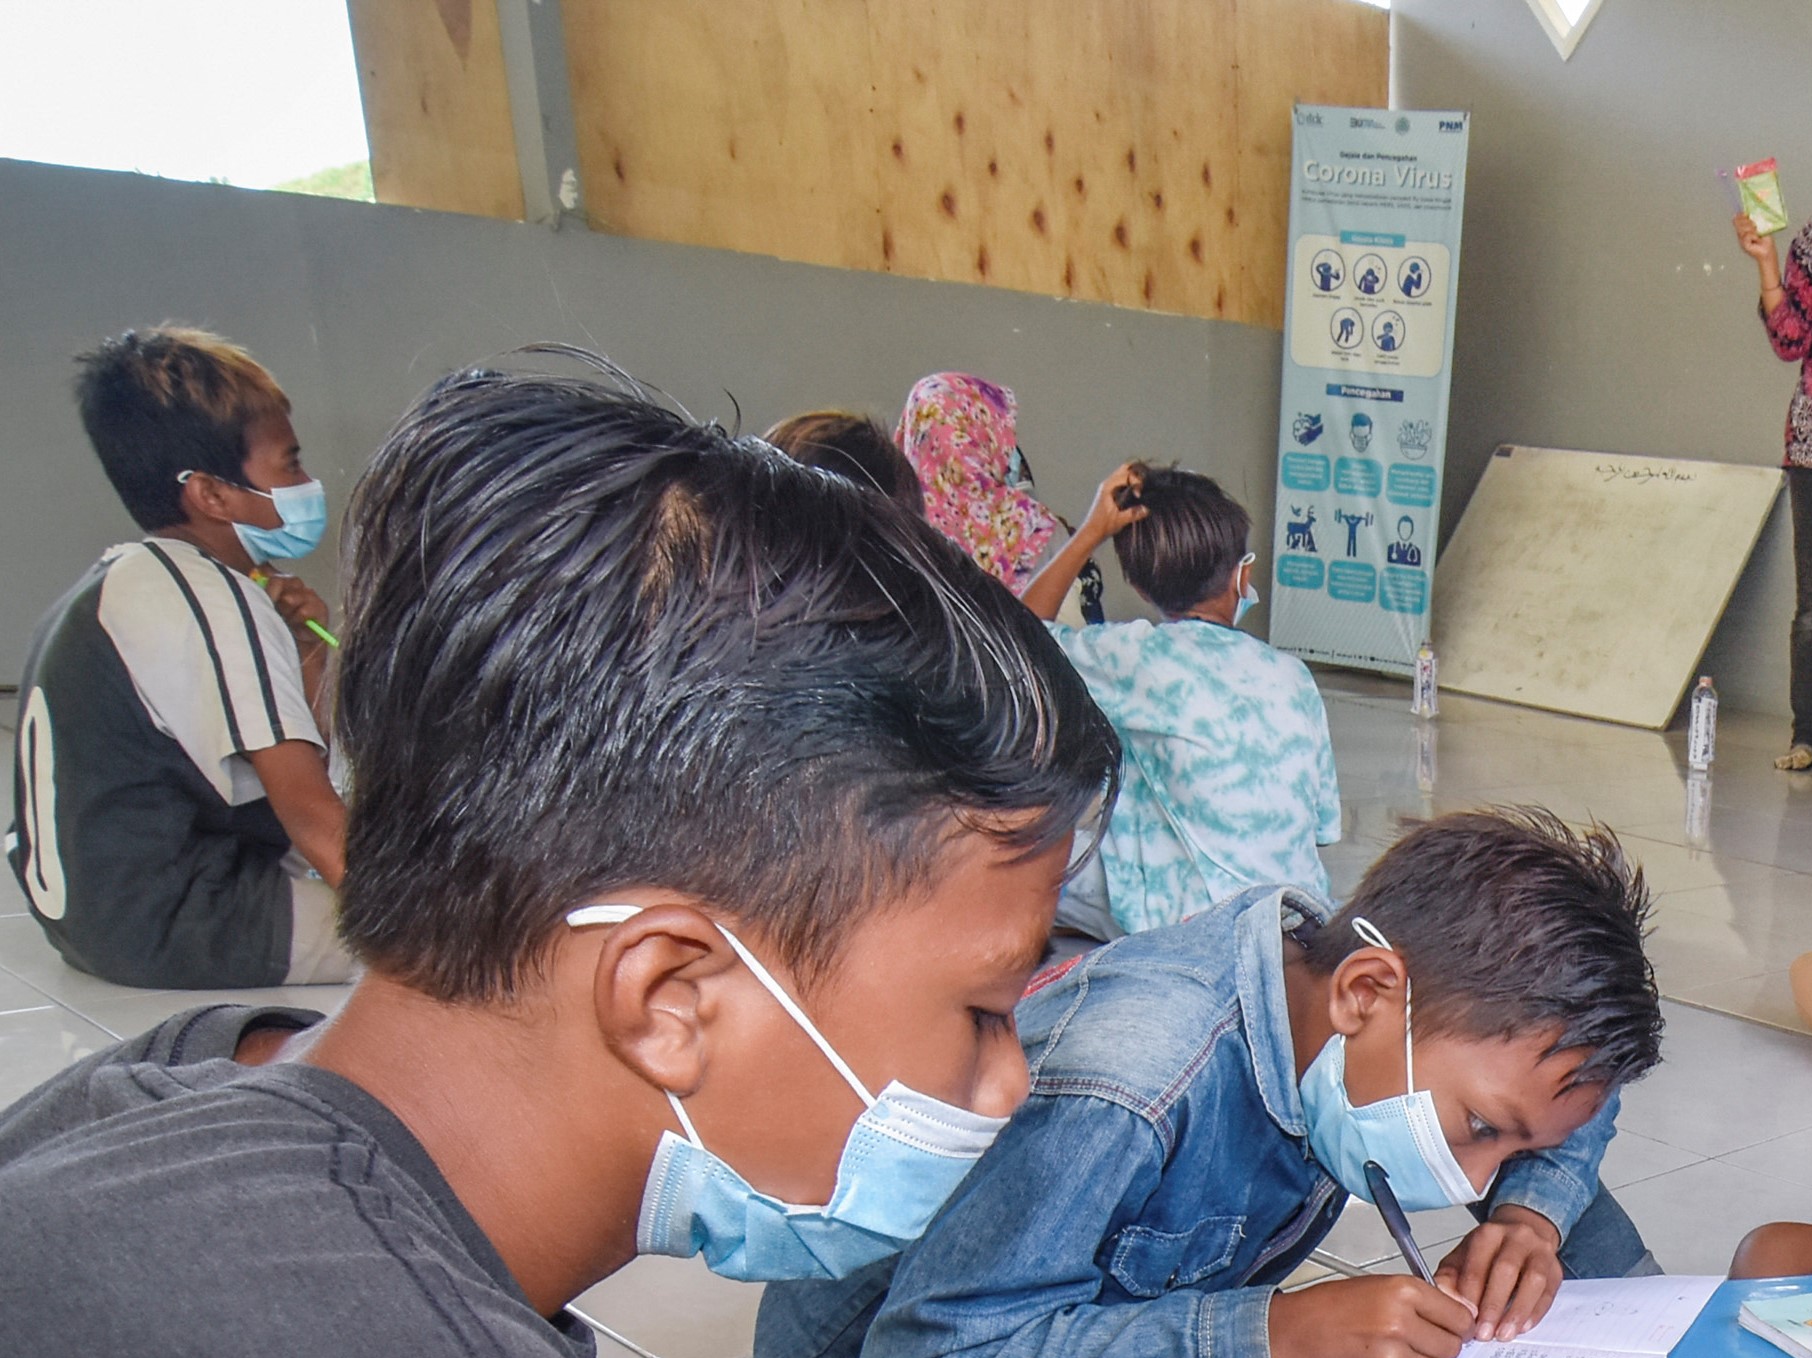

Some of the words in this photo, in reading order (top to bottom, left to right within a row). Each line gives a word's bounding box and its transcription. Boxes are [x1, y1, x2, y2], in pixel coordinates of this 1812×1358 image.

[1439, 121, 1463, 131] PNM
[1302, 159, 1386, 187] Corona
[1394, 163, 1453, 190] Virus
[1340, 382, 1391, 399] Pencegahan
